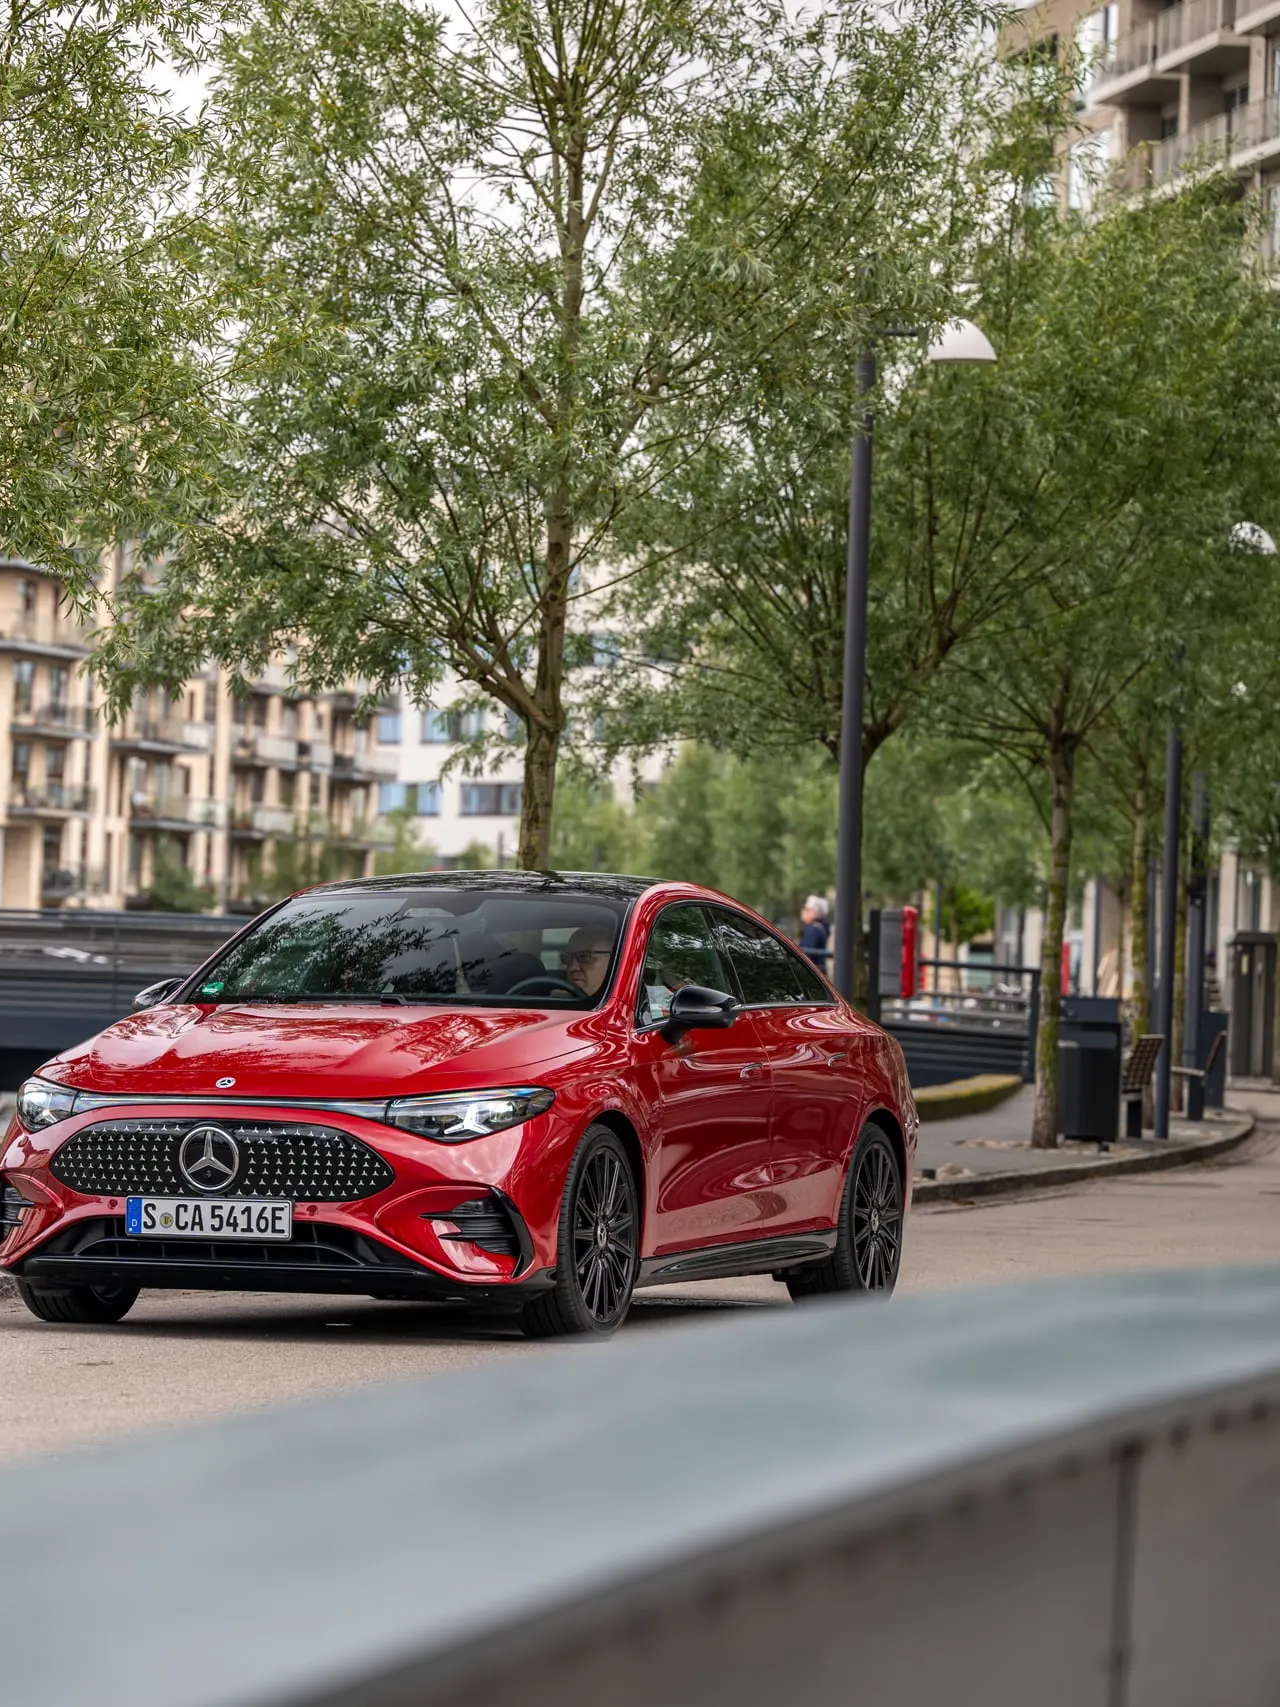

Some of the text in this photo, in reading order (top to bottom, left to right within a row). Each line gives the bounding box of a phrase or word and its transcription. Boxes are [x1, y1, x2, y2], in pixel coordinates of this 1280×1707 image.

[143, 1203, 285, 1234] S CA 5416E
